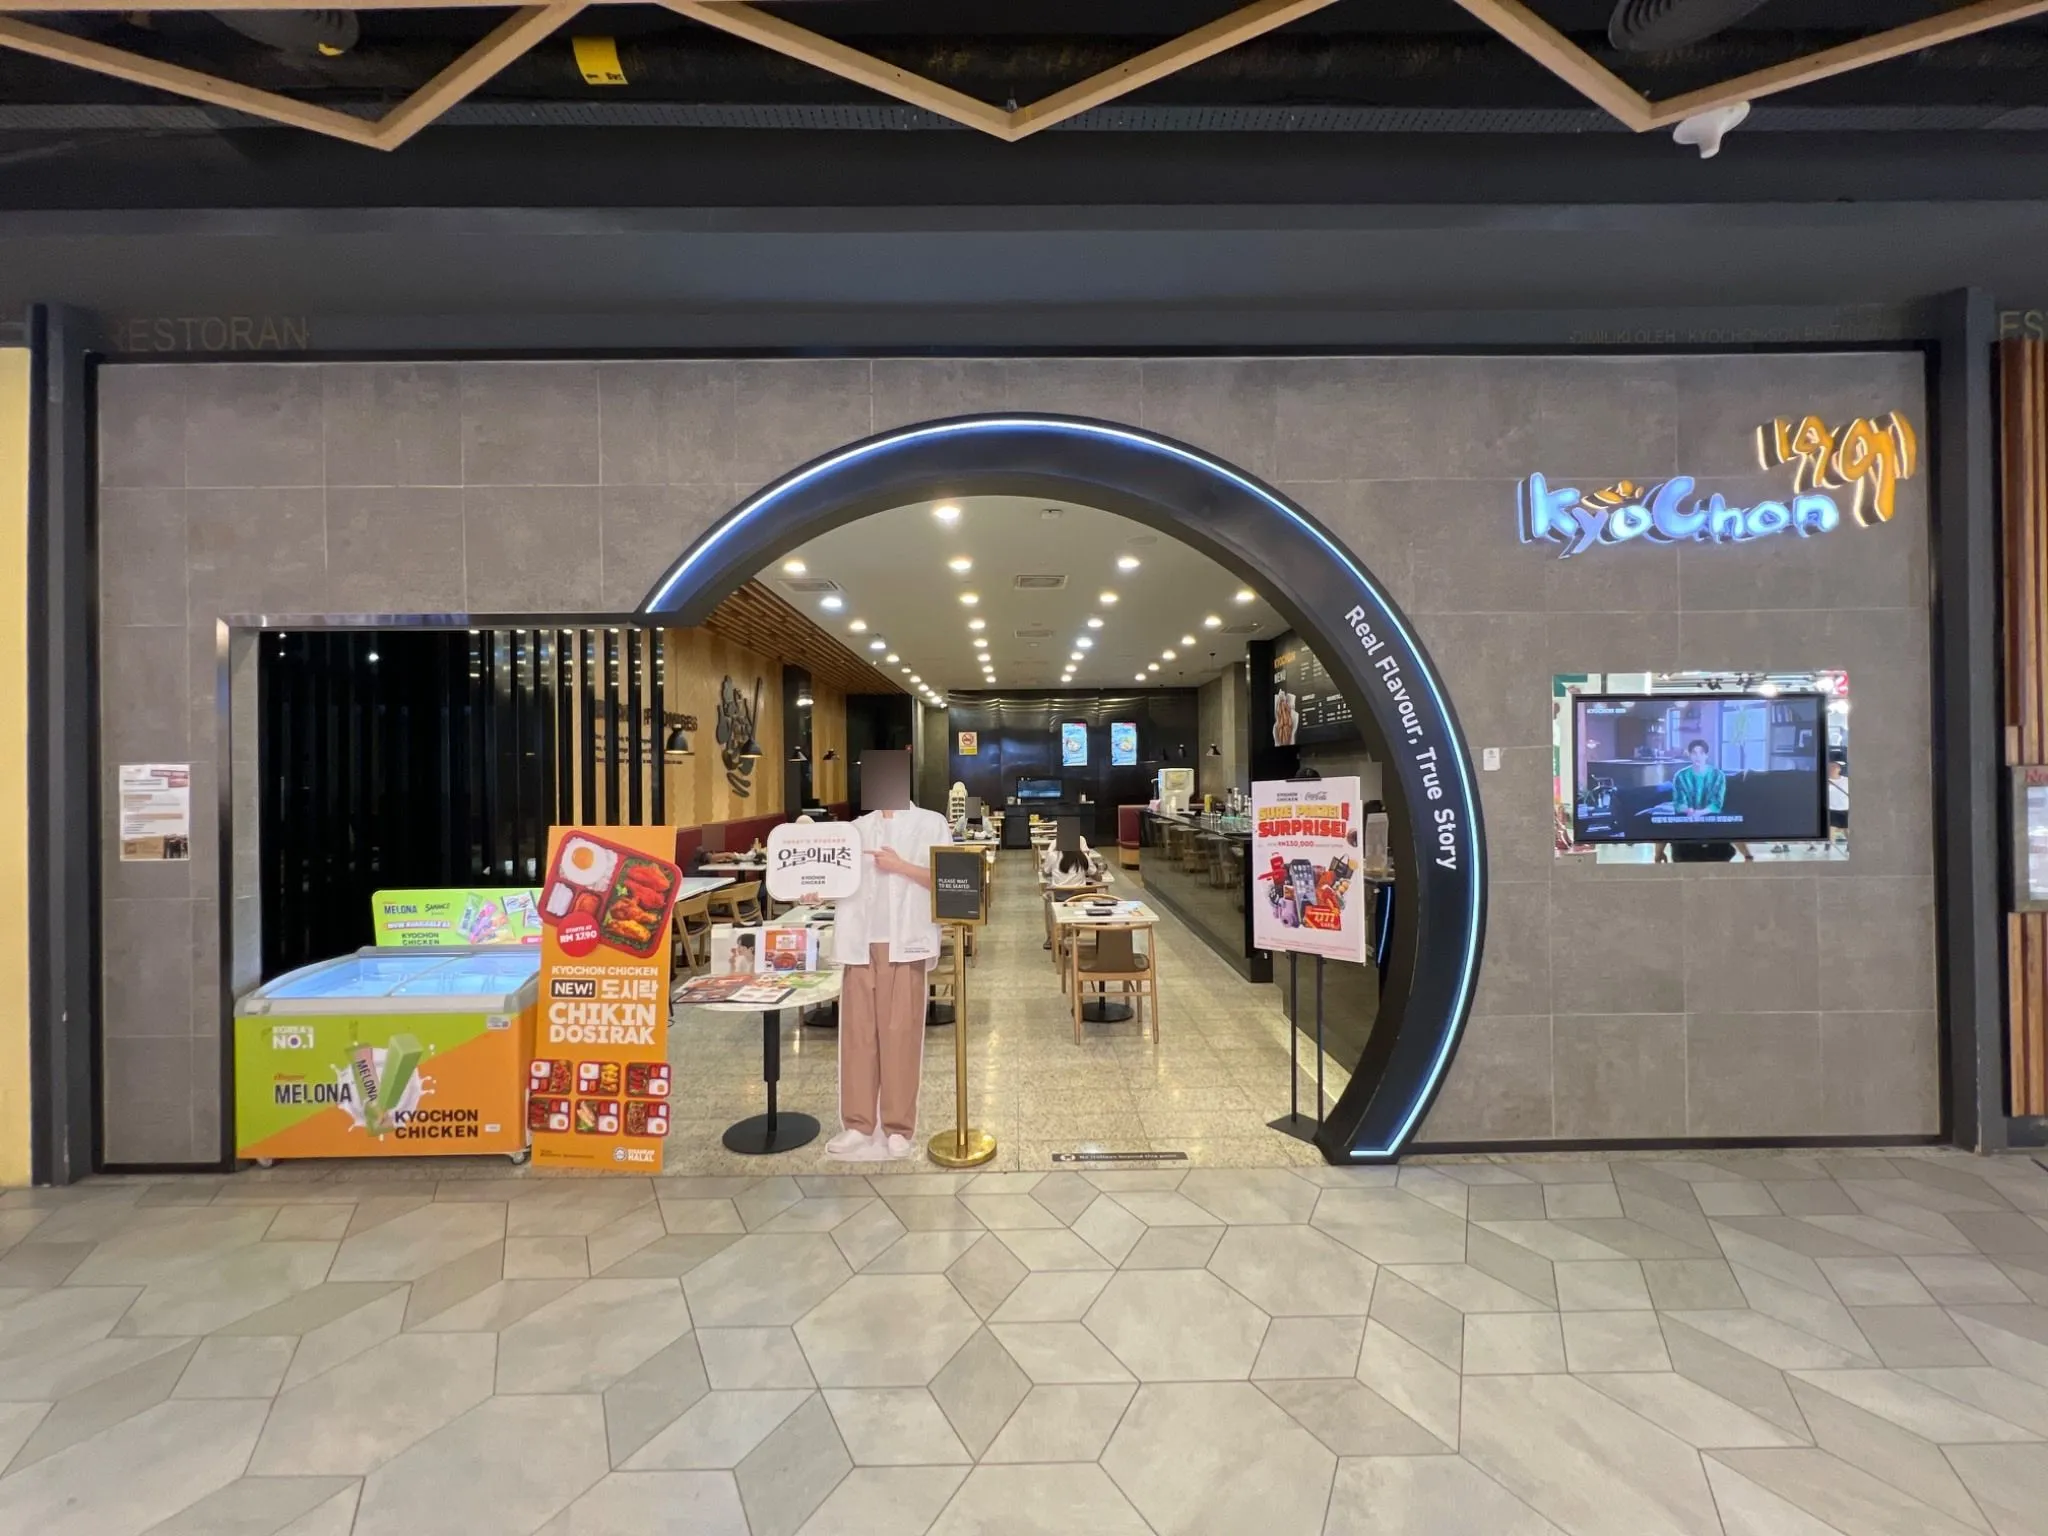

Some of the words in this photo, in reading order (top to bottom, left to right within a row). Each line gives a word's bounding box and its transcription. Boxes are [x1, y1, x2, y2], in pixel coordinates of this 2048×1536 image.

[1344, 605, 1385, 656] Real
[1375, 655, 1423, 745] Flavour,
[1415, 746, 1443, 800] True
[1434, 808, 1457, 870] Story
[1258, 819, 1347, 838] SURPRISE!
[384, 905, 417, 914] MELONA
[560, 935, 574, 943] RM
[551, 966, 606, 975] KYOCHON
[607, 967, 658, 976] CHICKEN
[554, 982, 593, 995] NEW!
[601, 979, 658, 1000] 도시락
[549, 1002, 656, 1026] CHIKIN
[272, 1034, 314, 1049] NO.1
[549, 1025, 656, 1045] DOSIRAK
[275, 1083, 352, 1104] MELONA
[395, 1109, 479, 1123] KYOCHON
[395, 1124, 479, 1139] CHICKEN
